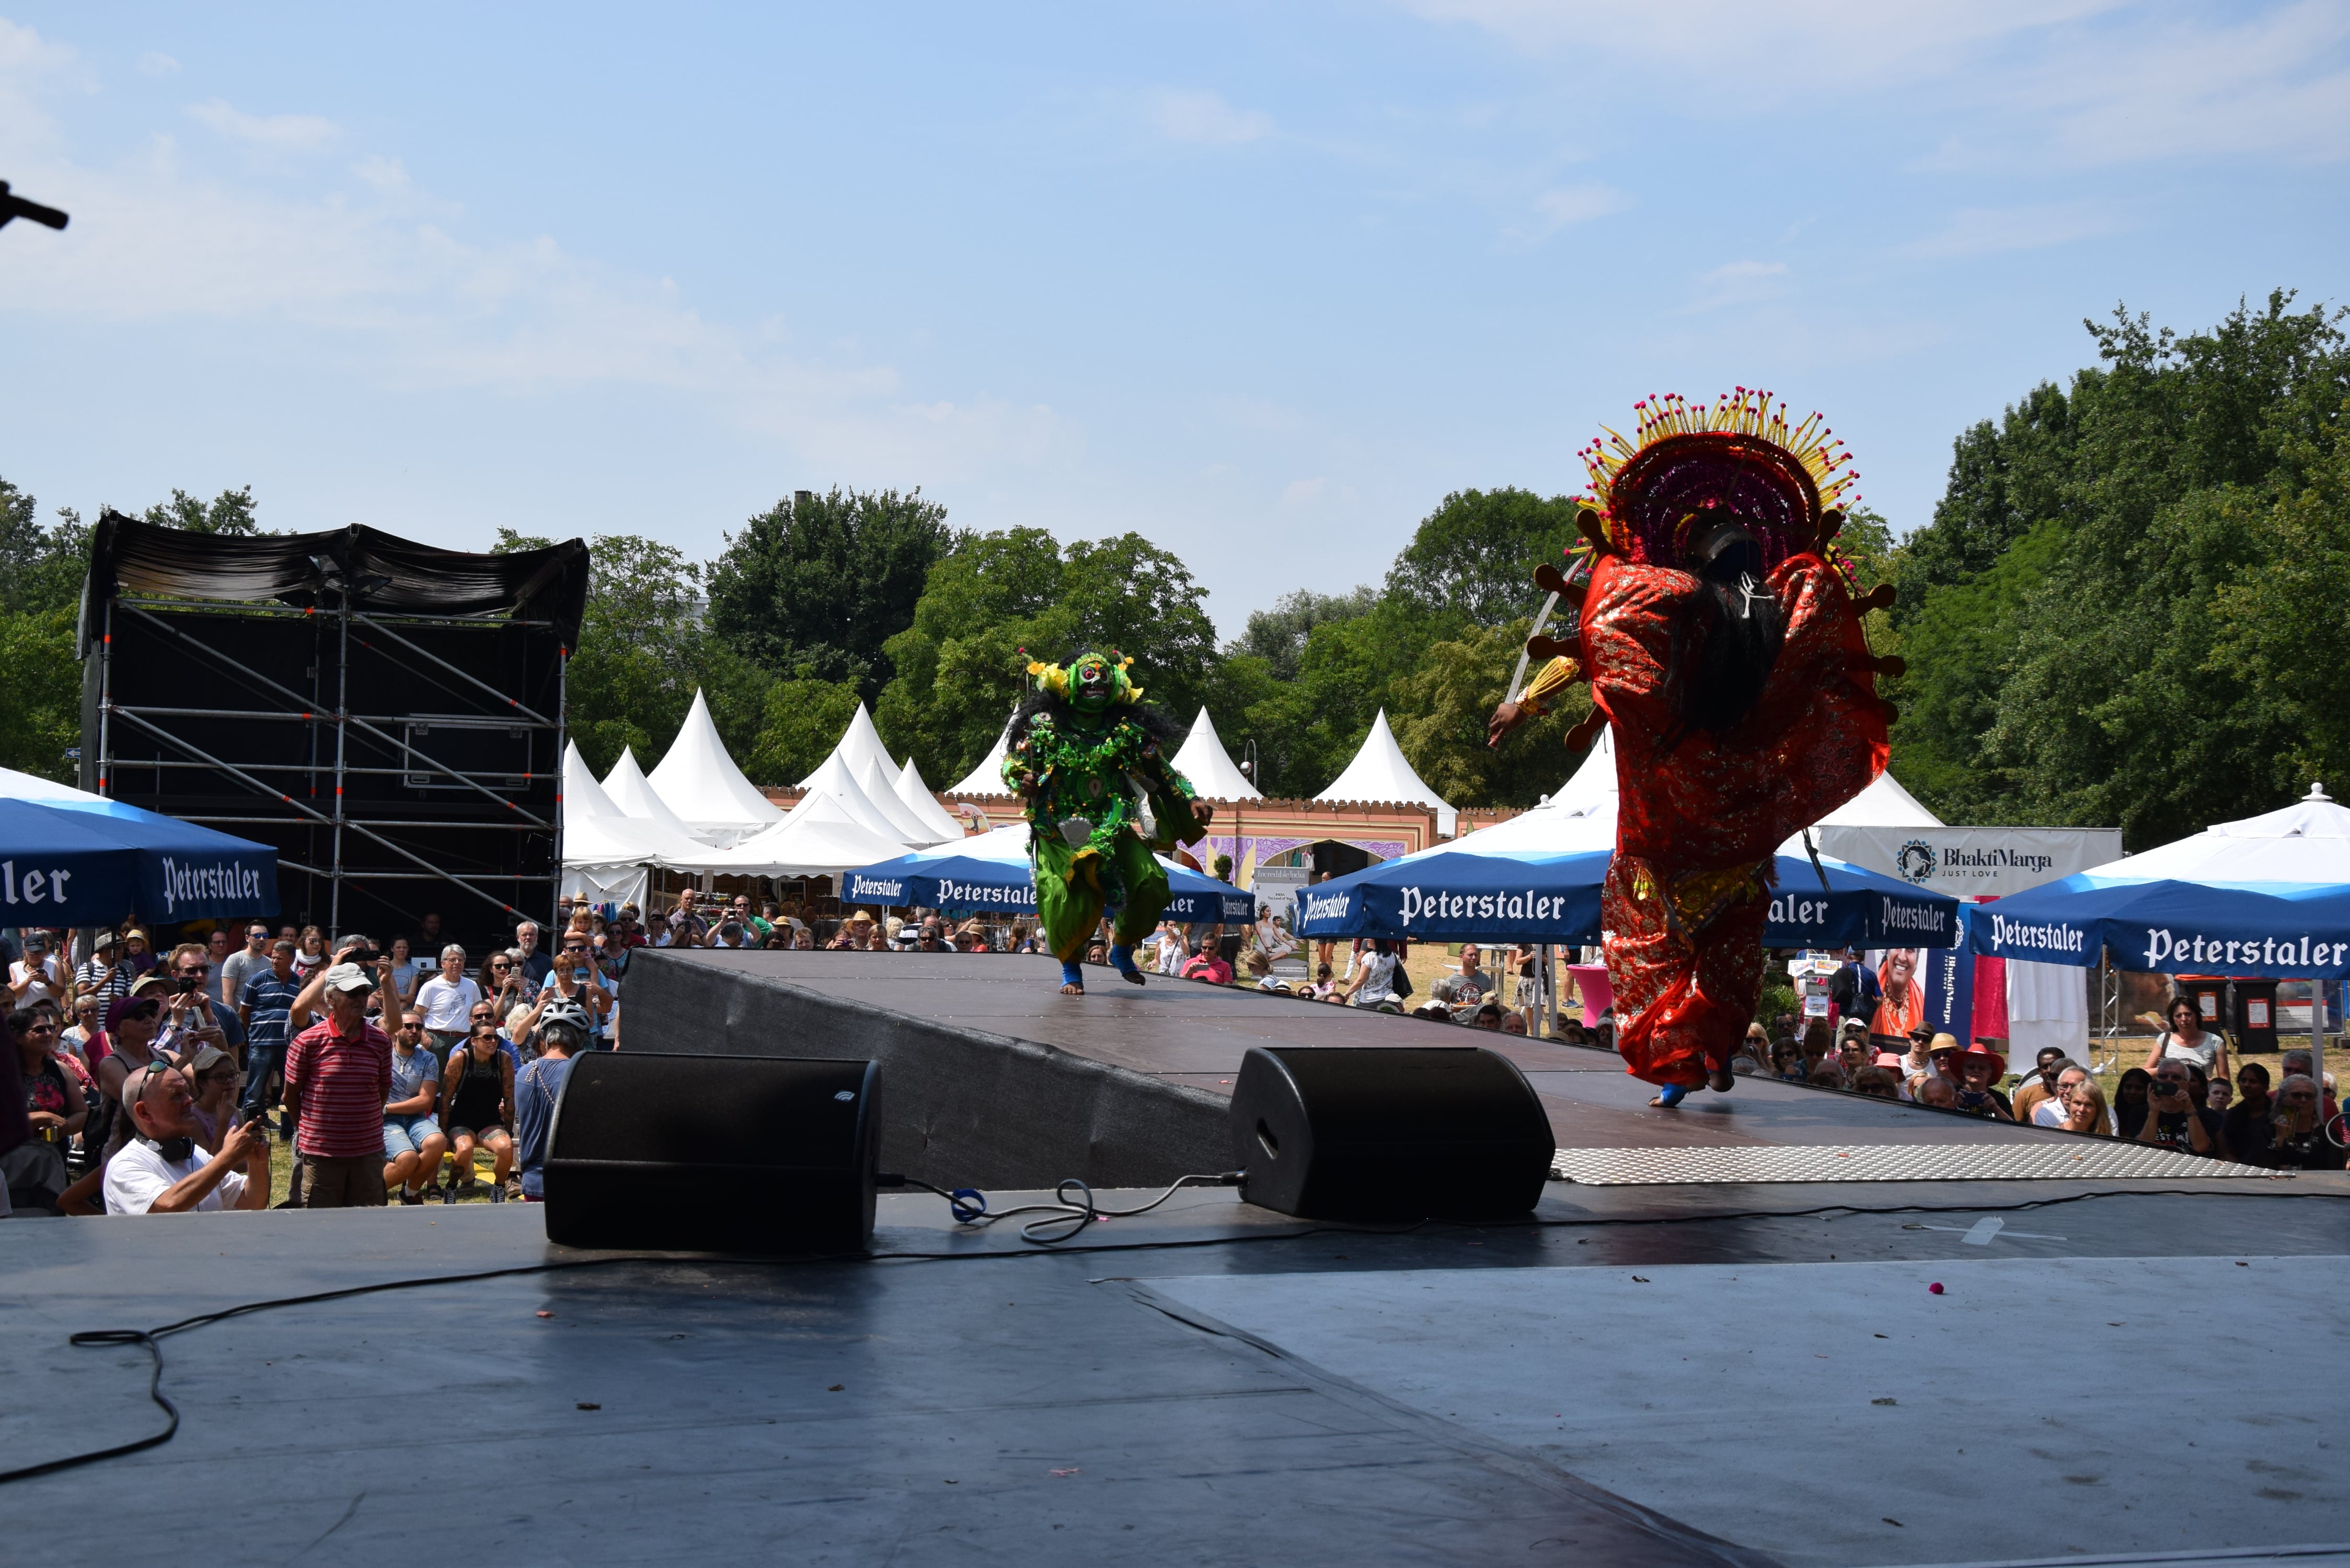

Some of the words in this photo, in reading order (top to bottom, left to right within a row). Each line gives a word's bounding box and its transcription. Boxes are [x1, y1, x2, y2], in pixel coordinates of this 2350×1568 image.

[1943, 848, 2053, 873] BhaktiMarga
[0, 860, 71, 905] ler
[163, 856, 260, 915] Peterstaler
[851, 874, 903, 898] Peterstaler
[936, 879, 1037, 905] Peterstale
[1303, 891, 1350, 929] Peterstaler
[1398, 886, 1565, 927] Peterstaler
[1881, 896, 1945, 936] Peterstaler
[1991, 914, 2083, 952] Peterstaler
[2142, 928, 2348, 968] Peterstaler
